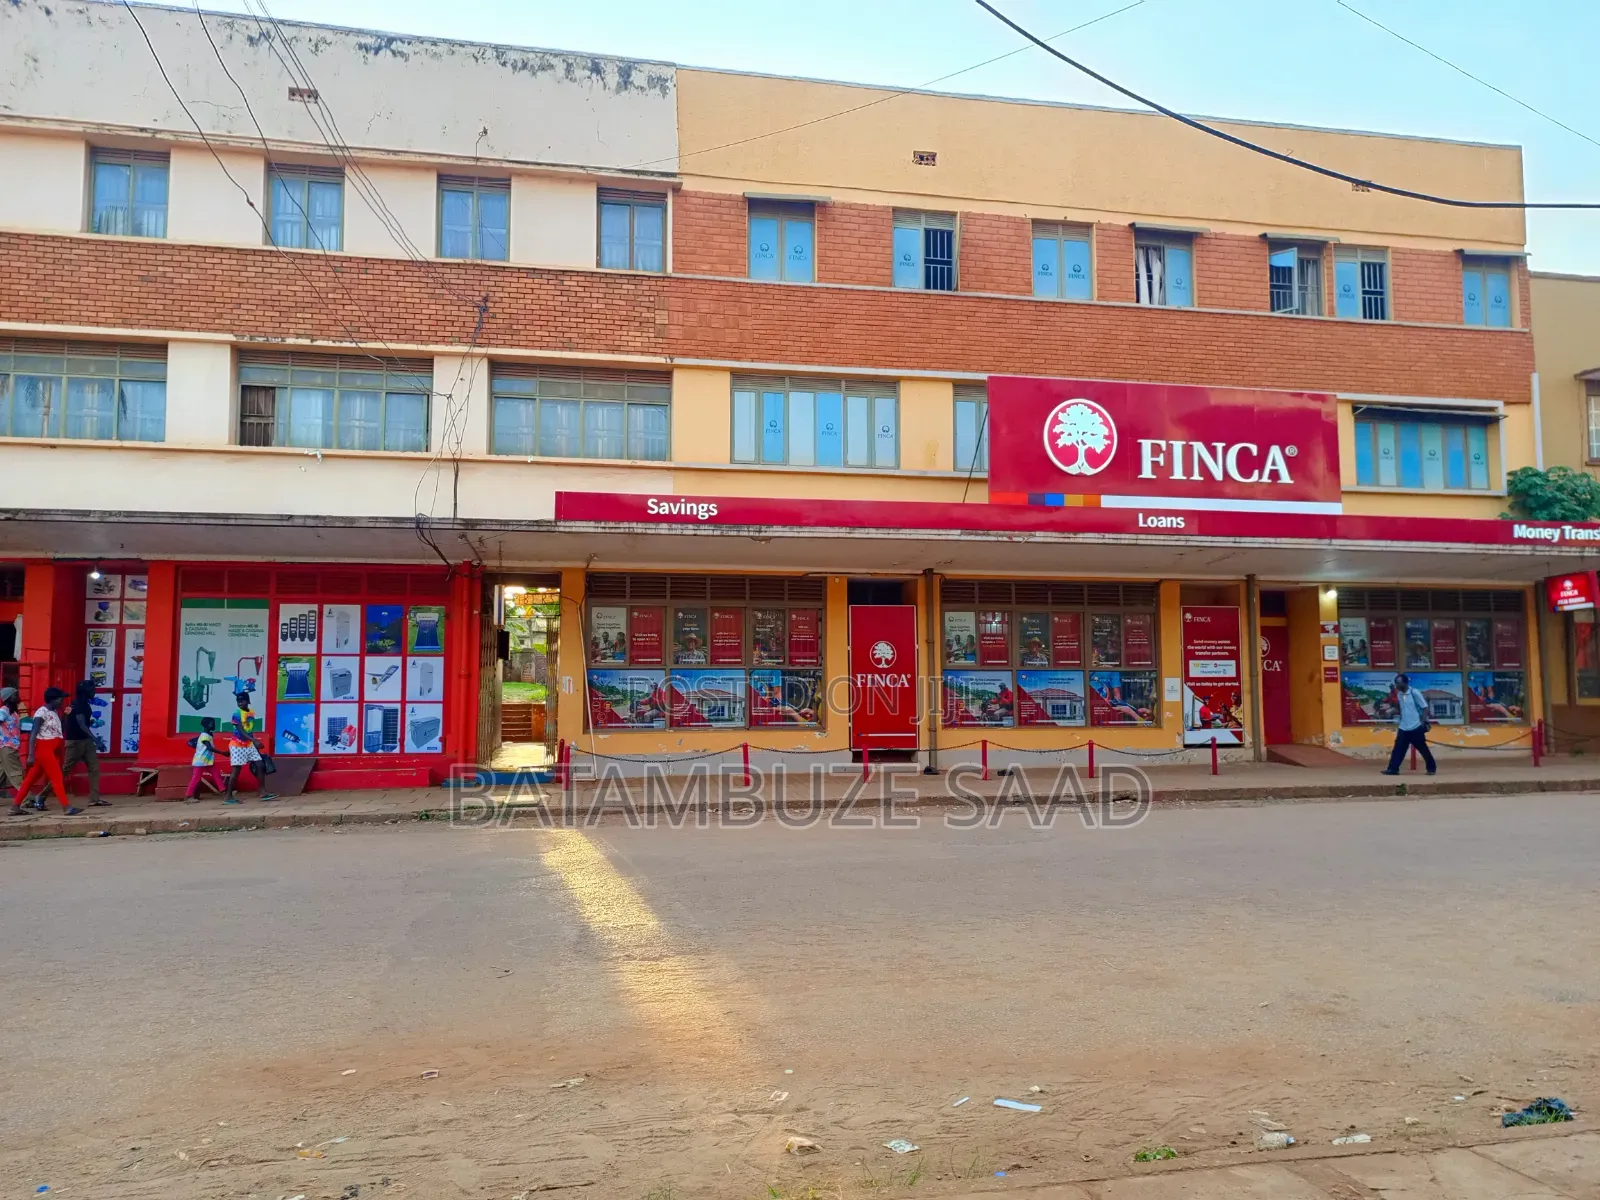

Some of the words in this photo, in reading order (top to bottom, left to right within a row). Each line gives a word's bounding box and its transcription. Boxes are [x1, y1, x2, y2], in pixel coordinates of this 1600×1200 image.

[647, 498, 718, 520] Savings
[1138, 512, 1185, 528] Loans
[1513, 524, 1560, 543] Money
